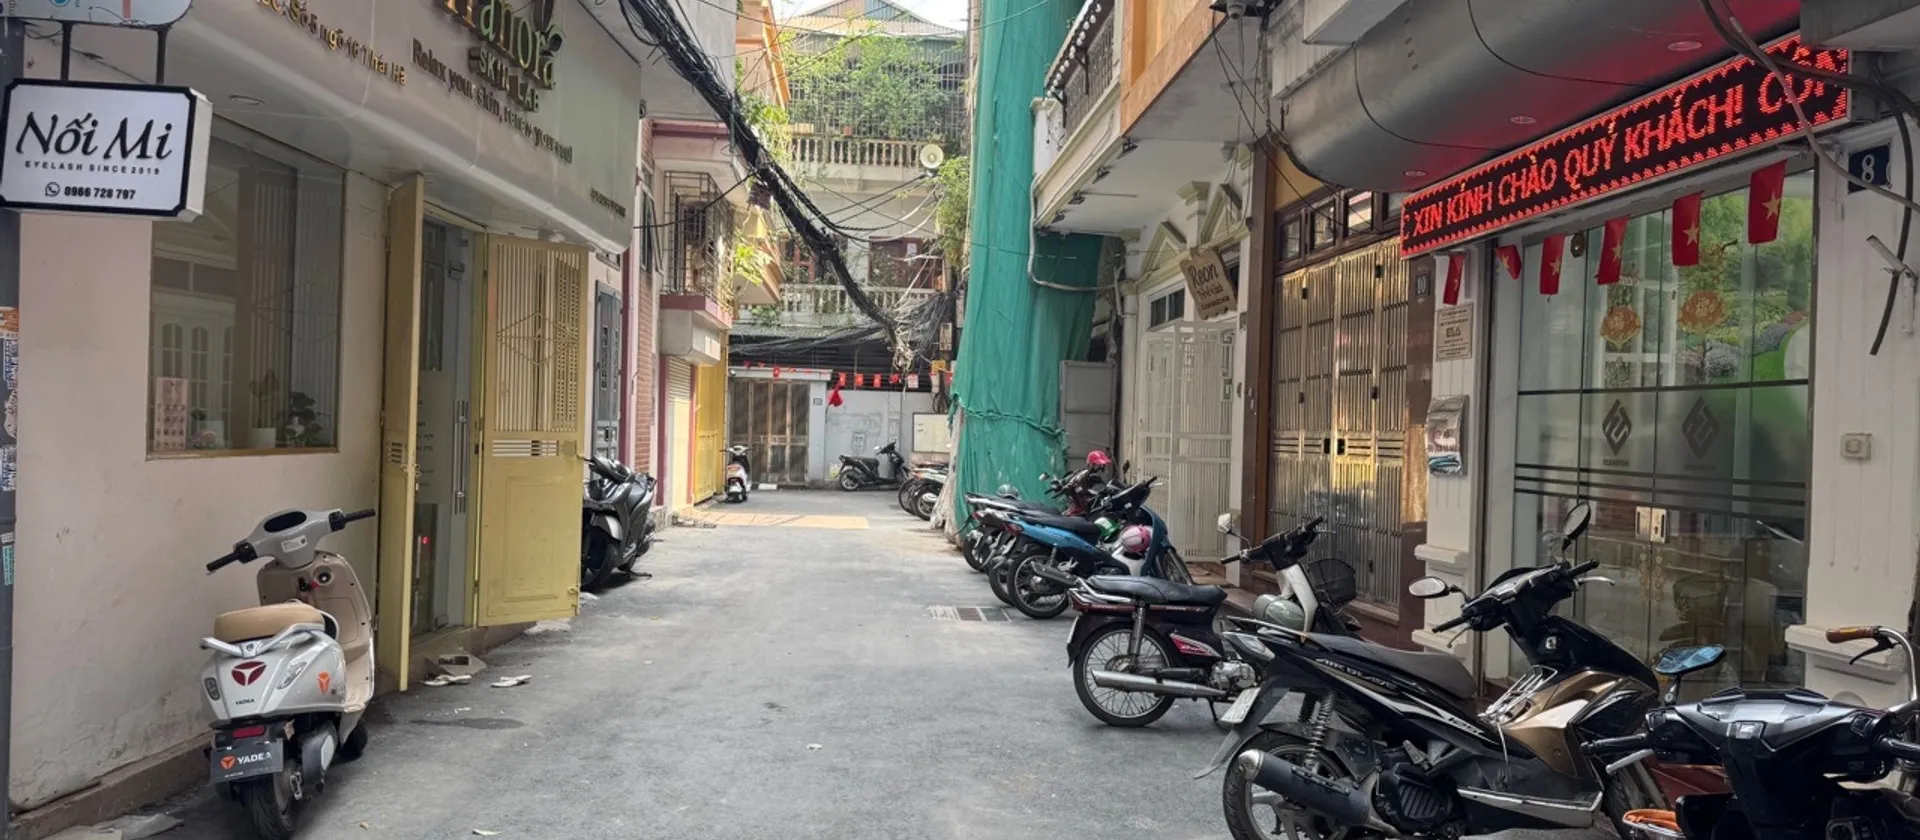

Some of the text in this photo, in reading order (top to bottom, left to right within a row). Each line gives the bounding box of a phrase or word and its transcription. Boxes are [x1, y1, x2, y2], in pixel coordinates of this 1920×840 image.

[412, 38, 447, 83] Relax
[15, 111, 172, 160] Nối Mi
[25, 160, 160, 175] EYELASH SINCE 2019
[1413, 202, 1443, 237] XIN
[1446, 182, 1493, 225] KÍNH
[1498, 154, 1558, 207] CHÀO
[1564, 121, 1618, 190] QUÝ
[1624, 94, 1744, 163] KHÁCH!
[64, 186, 91, 198] 0966
[116, 189, 136, 200] 797
[237, 751, 272, 765] YADEA
